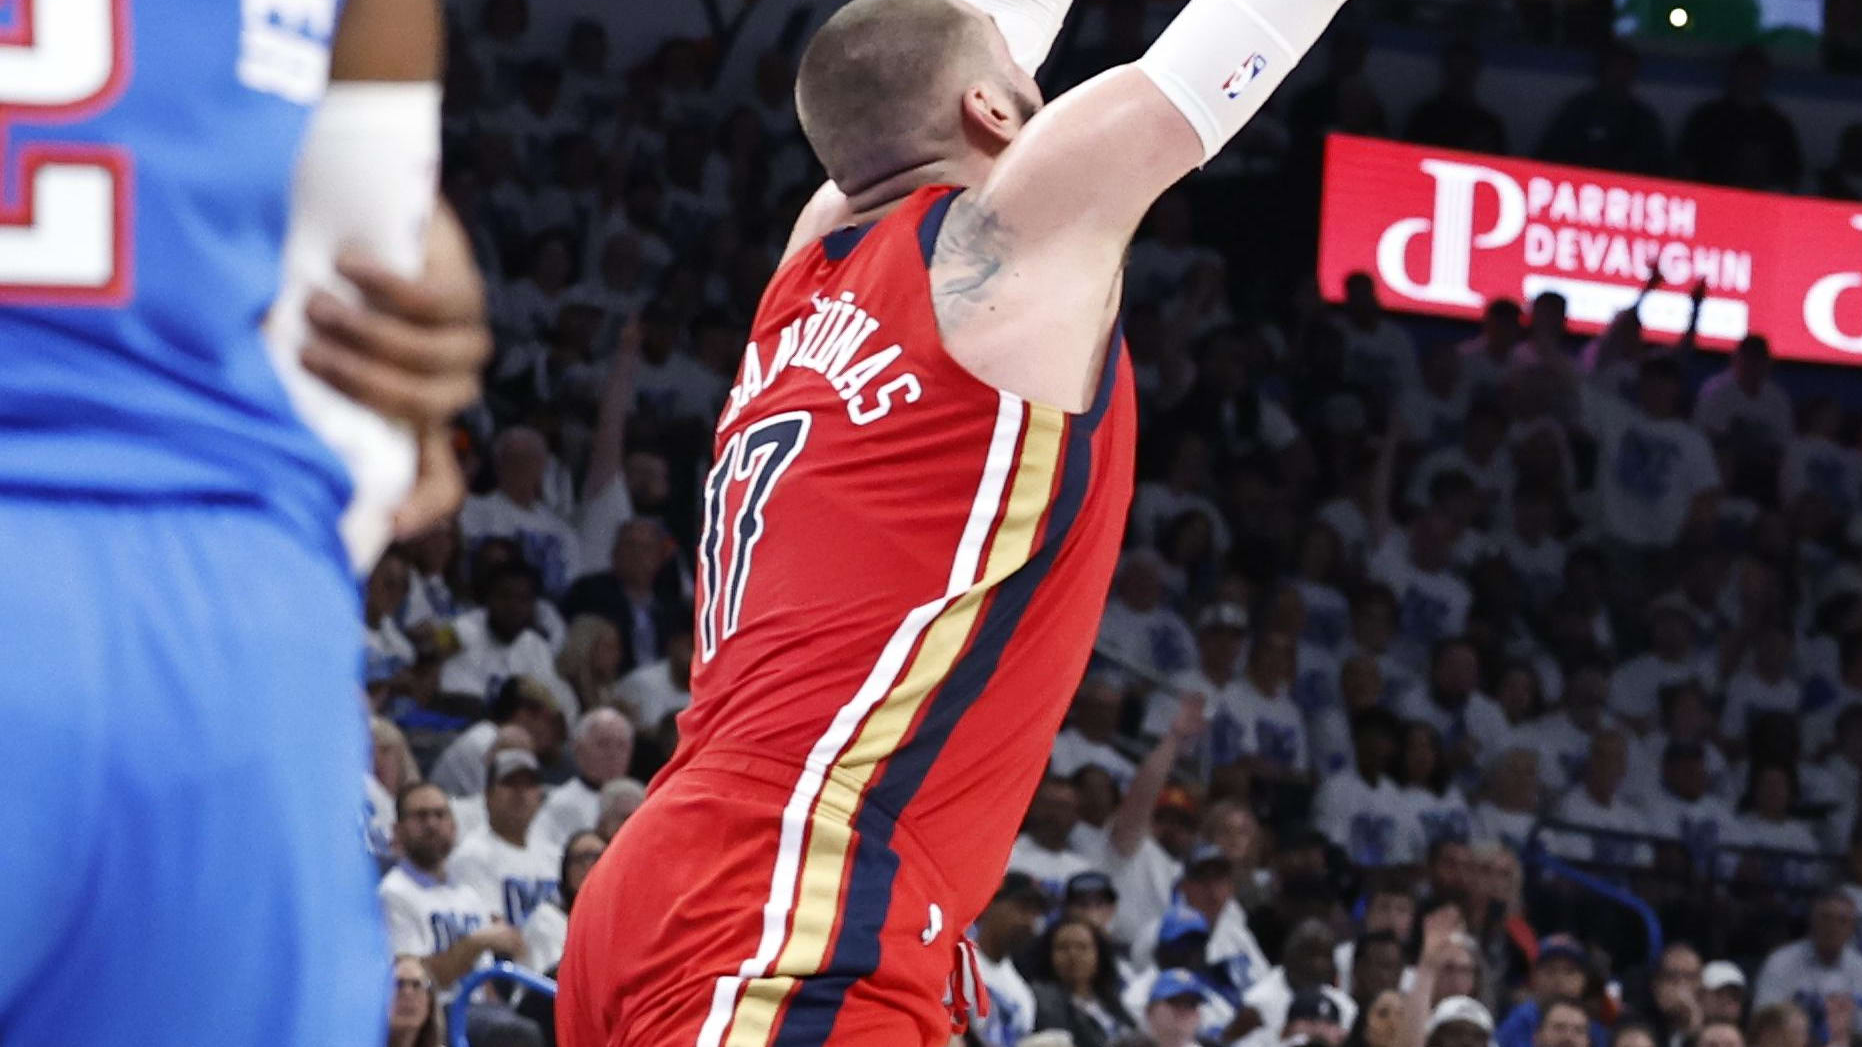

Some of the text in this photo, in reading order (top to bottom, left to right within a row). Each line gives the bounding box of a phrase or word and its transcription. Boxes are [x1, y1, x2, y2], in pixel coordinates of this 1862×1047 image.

[1527, 176, 1697, 239] PARRISH
[1523, 222, 1752, 294] DEVAUGHN
[699, 411, 812, 664] 17
